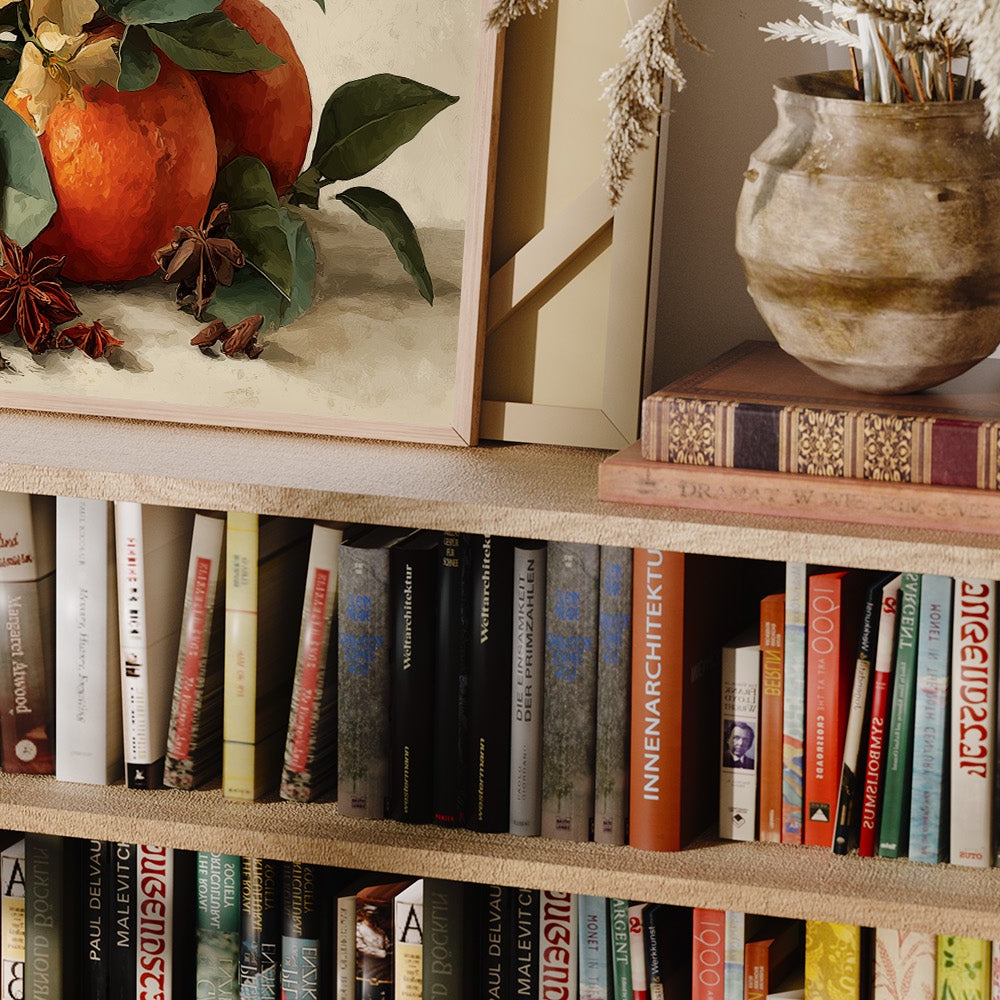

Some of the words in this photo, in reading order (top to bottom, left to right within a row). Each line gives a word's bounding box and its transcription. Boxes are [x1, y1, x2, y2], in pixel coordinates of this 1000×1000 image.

[5, 594, 26, 658] Margaret
[402, 563, 412, 671] Weltarchitektur
[515, 575, 526, 687] EINSAMKEIT
[524, 559, 535, 680] PRIMZAHLEN
[11, 659, 34, 714] Atwood
[523, 685, 533, 723] DER
[643, 548, 663, 801] INNENARCHITEKTU
[516, 692, 524, 723] DIE
[402, 746, 410, 814] westermann
[478, 737, 486, 821] westermann
[89, 839, 102, 911] DELVAU
[89, 915, 102, 961] PAUL
[488, 884, 502, 958] DELVAU
[587, 914, 599, 952] MONET
[629, 916, 642, 934] 2
[648, 926, 660, 976] Werkkunst
[587, 957, 599, 970] IN
[652, 975, 661, 983] &
[694, 921, 722, 987] 1900
